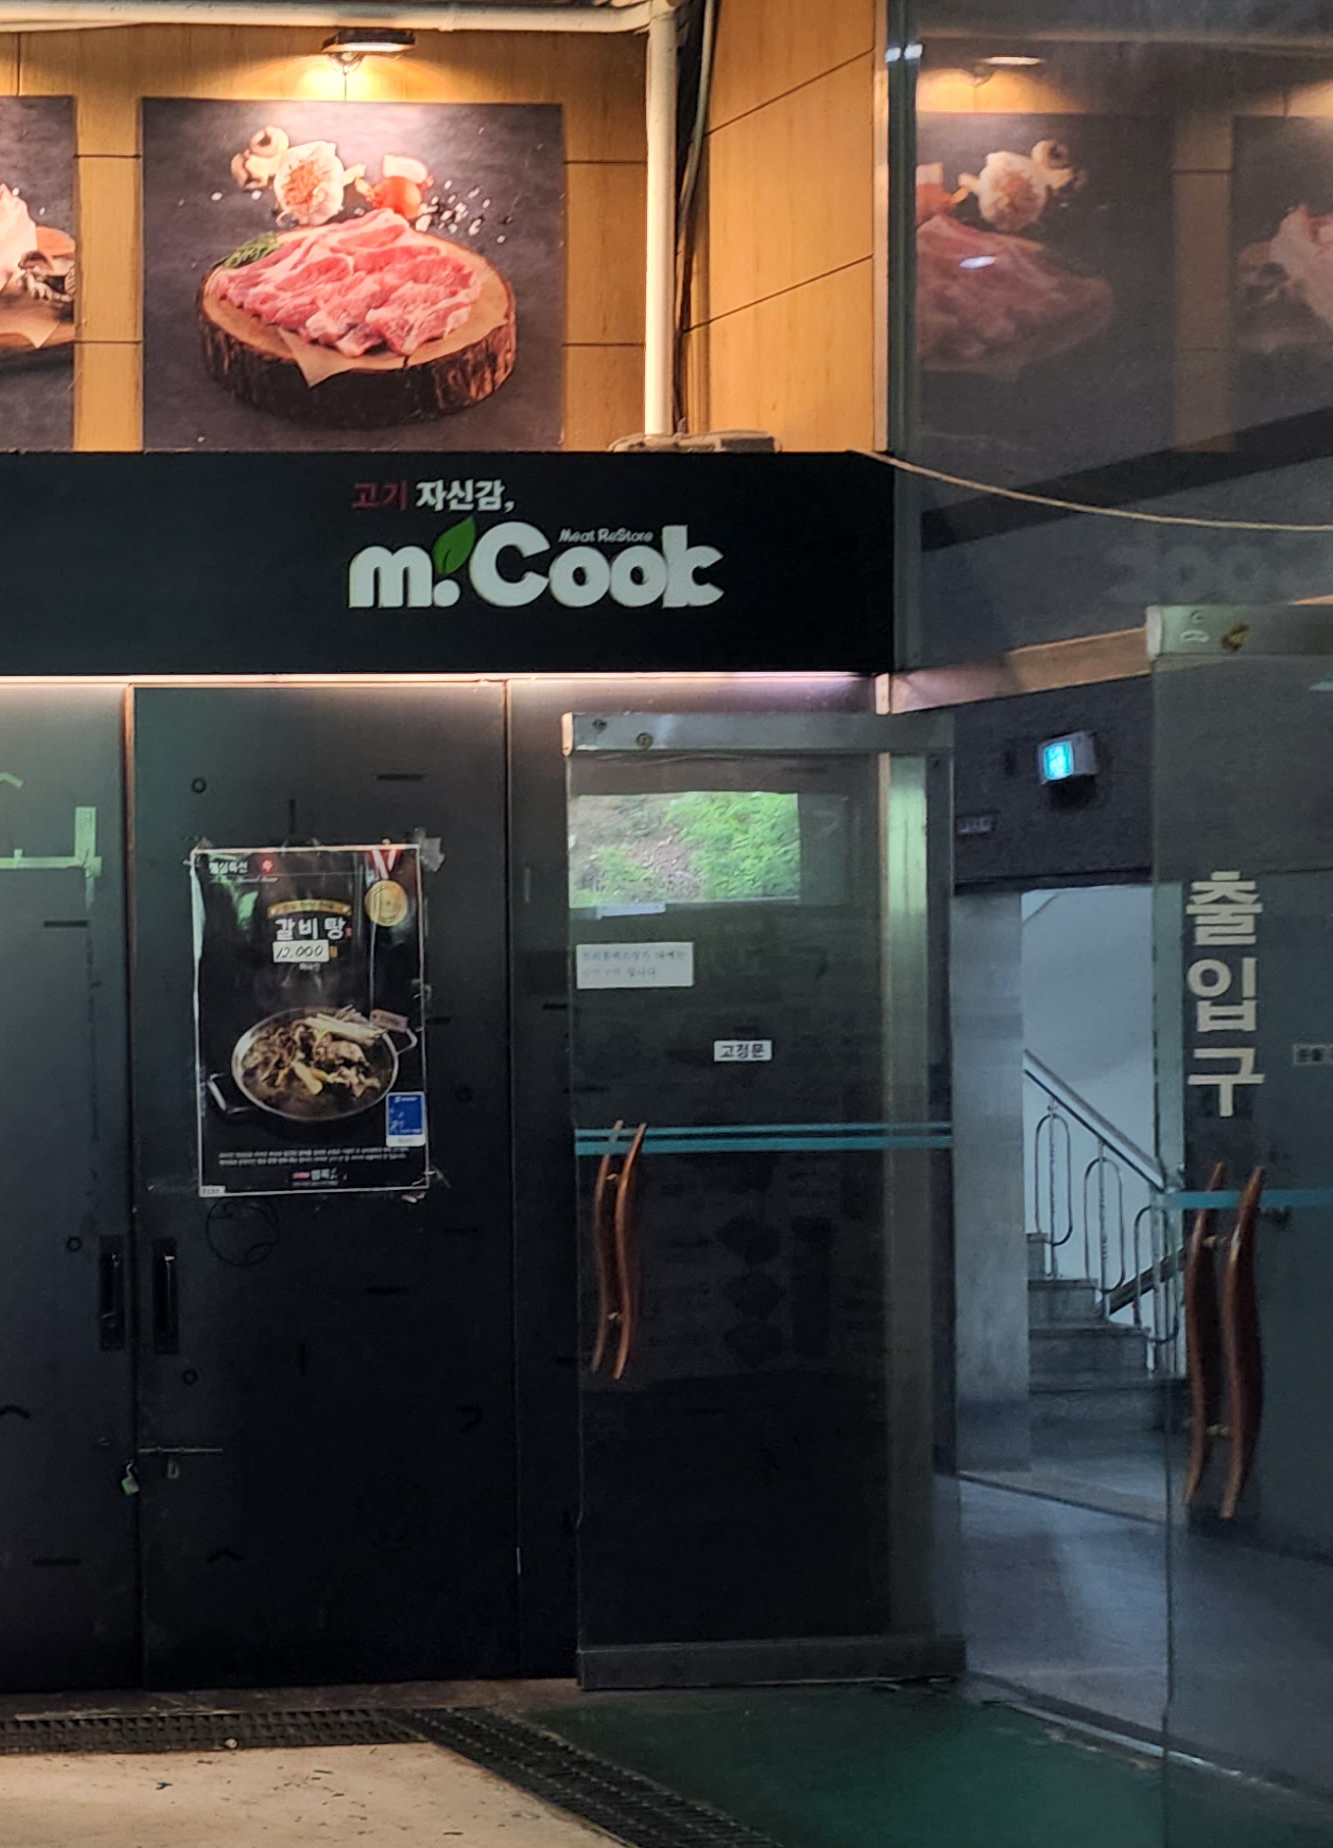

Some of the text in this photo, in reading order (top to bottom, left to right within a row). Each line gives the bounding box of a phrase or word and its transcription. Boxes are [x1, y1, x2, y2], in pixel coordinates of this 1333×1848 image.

[352, 480, 514, 513] 고기 자신감,
[274, 916, 347, 941] 갈비탕
[1185, 870, 1265, 1118] 출입구
[720, 1043, 765, 1059] 고정문
